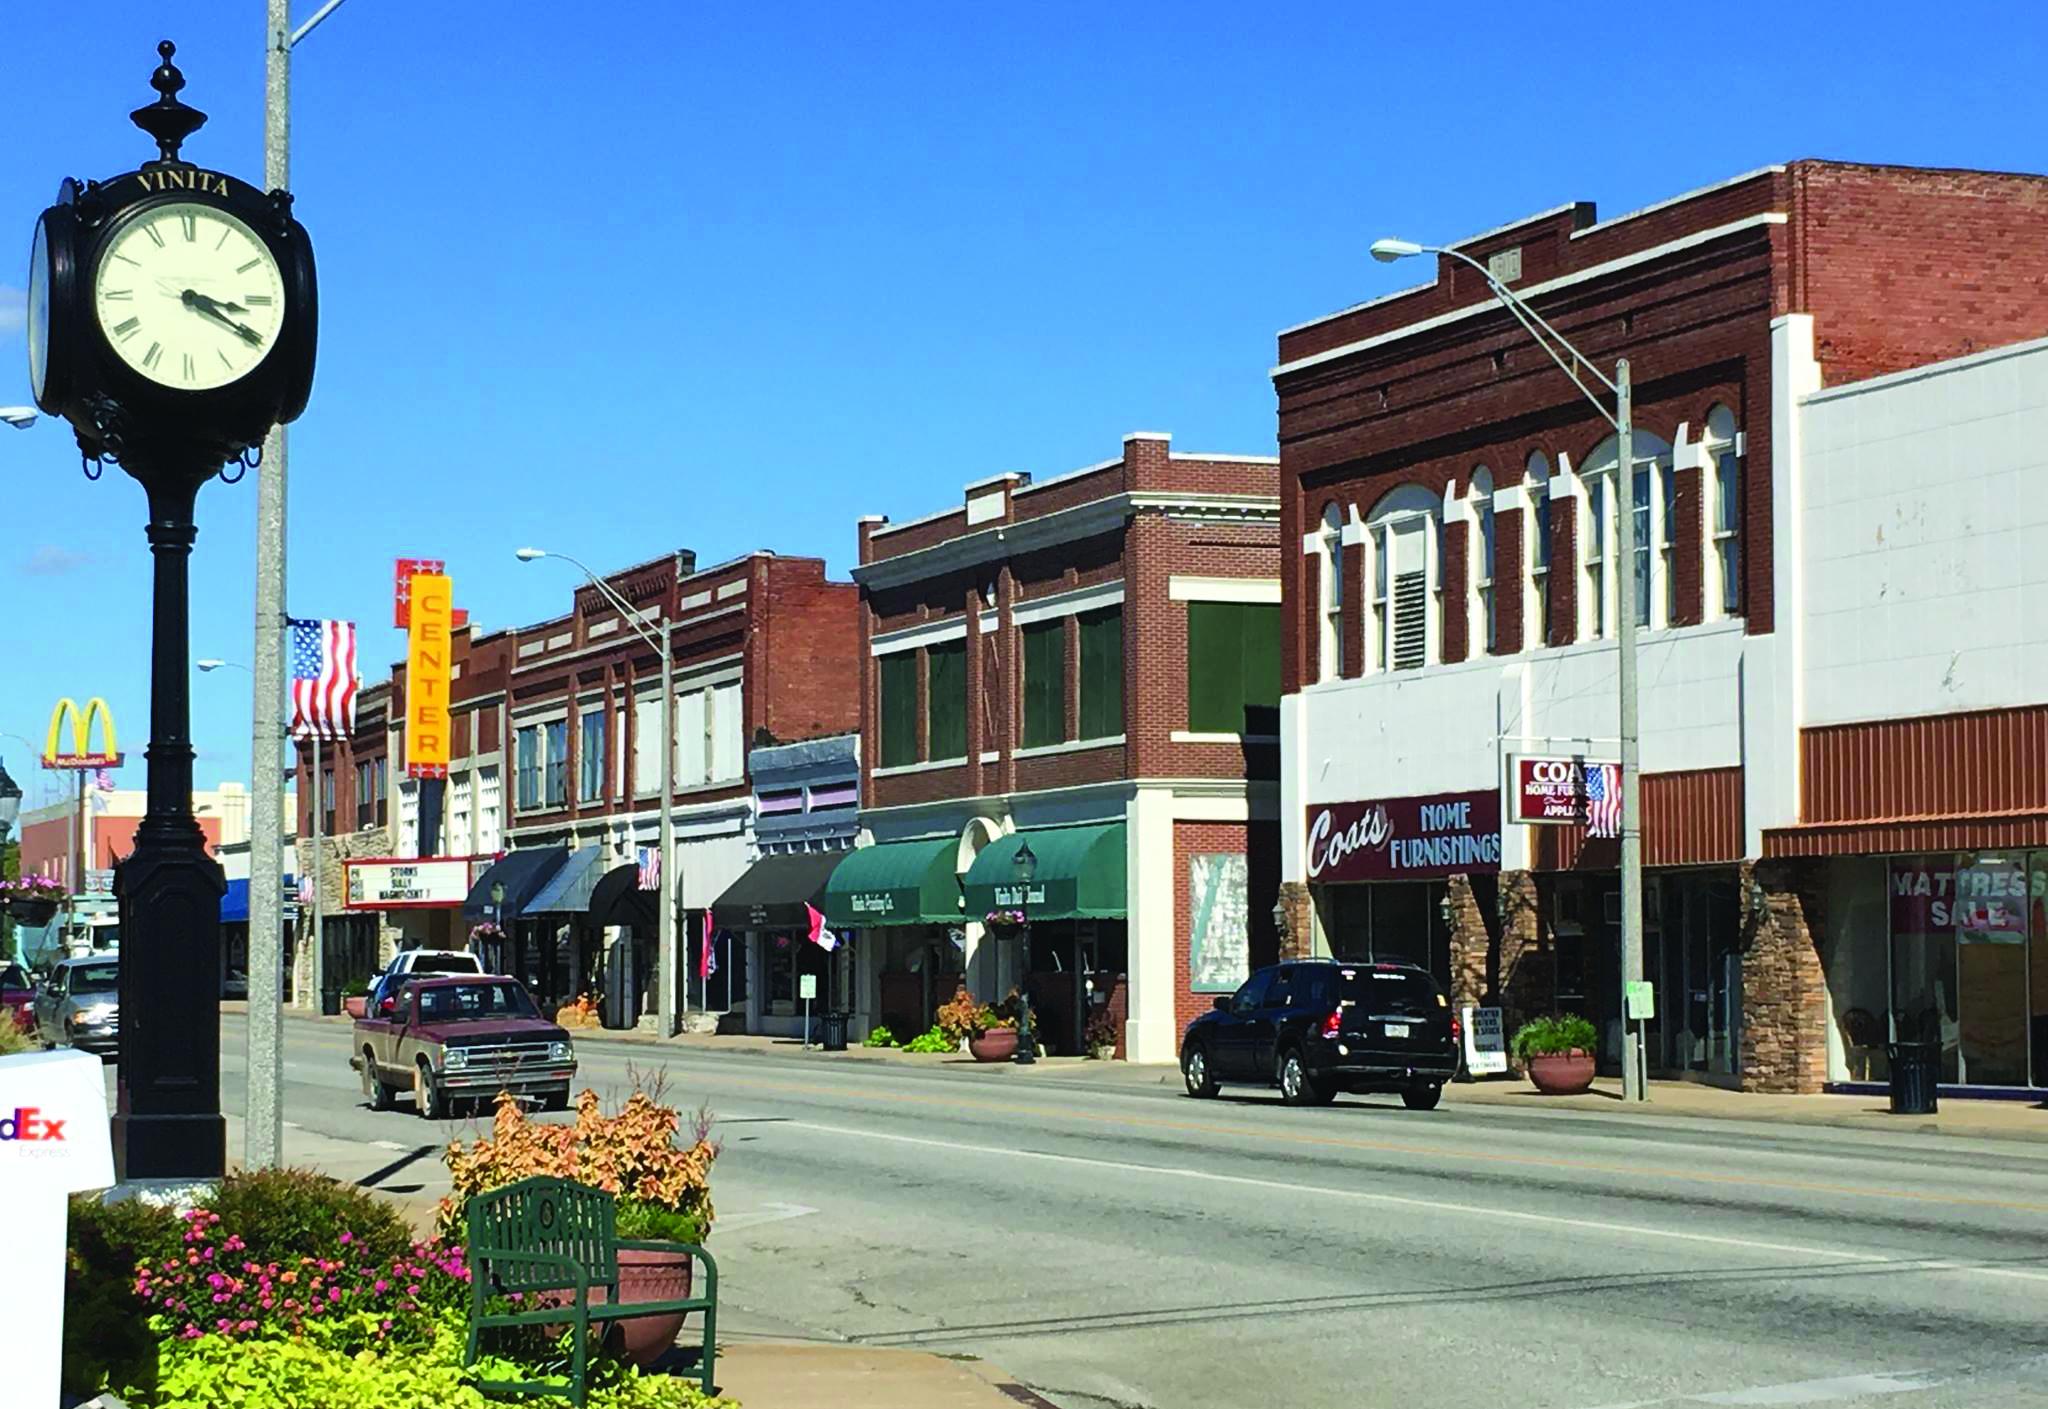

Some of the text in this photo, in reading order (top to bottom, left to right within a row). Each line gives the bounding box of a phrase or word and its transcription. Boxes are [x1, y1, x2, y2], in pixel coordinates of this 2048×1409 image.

[137, 170, 229, 197] VINITA
[418, 595, 443, 753] CENTER
[1525, 785, 1556, 796] HOME
[1421, 802, 1472, 833] HOME
[1308, 809, 1388, 878] Coats
[1390, 833, 1500, 869] FURNISHINGS
[391, 878, 412, 889] SULLY
[1893, 870, 2046, 897] MATTRESS
[1930, 901, 2009, 926] SALE
[0, 1106, 68, 1141] dEx
[19, 1144, 71, 1159] Express
